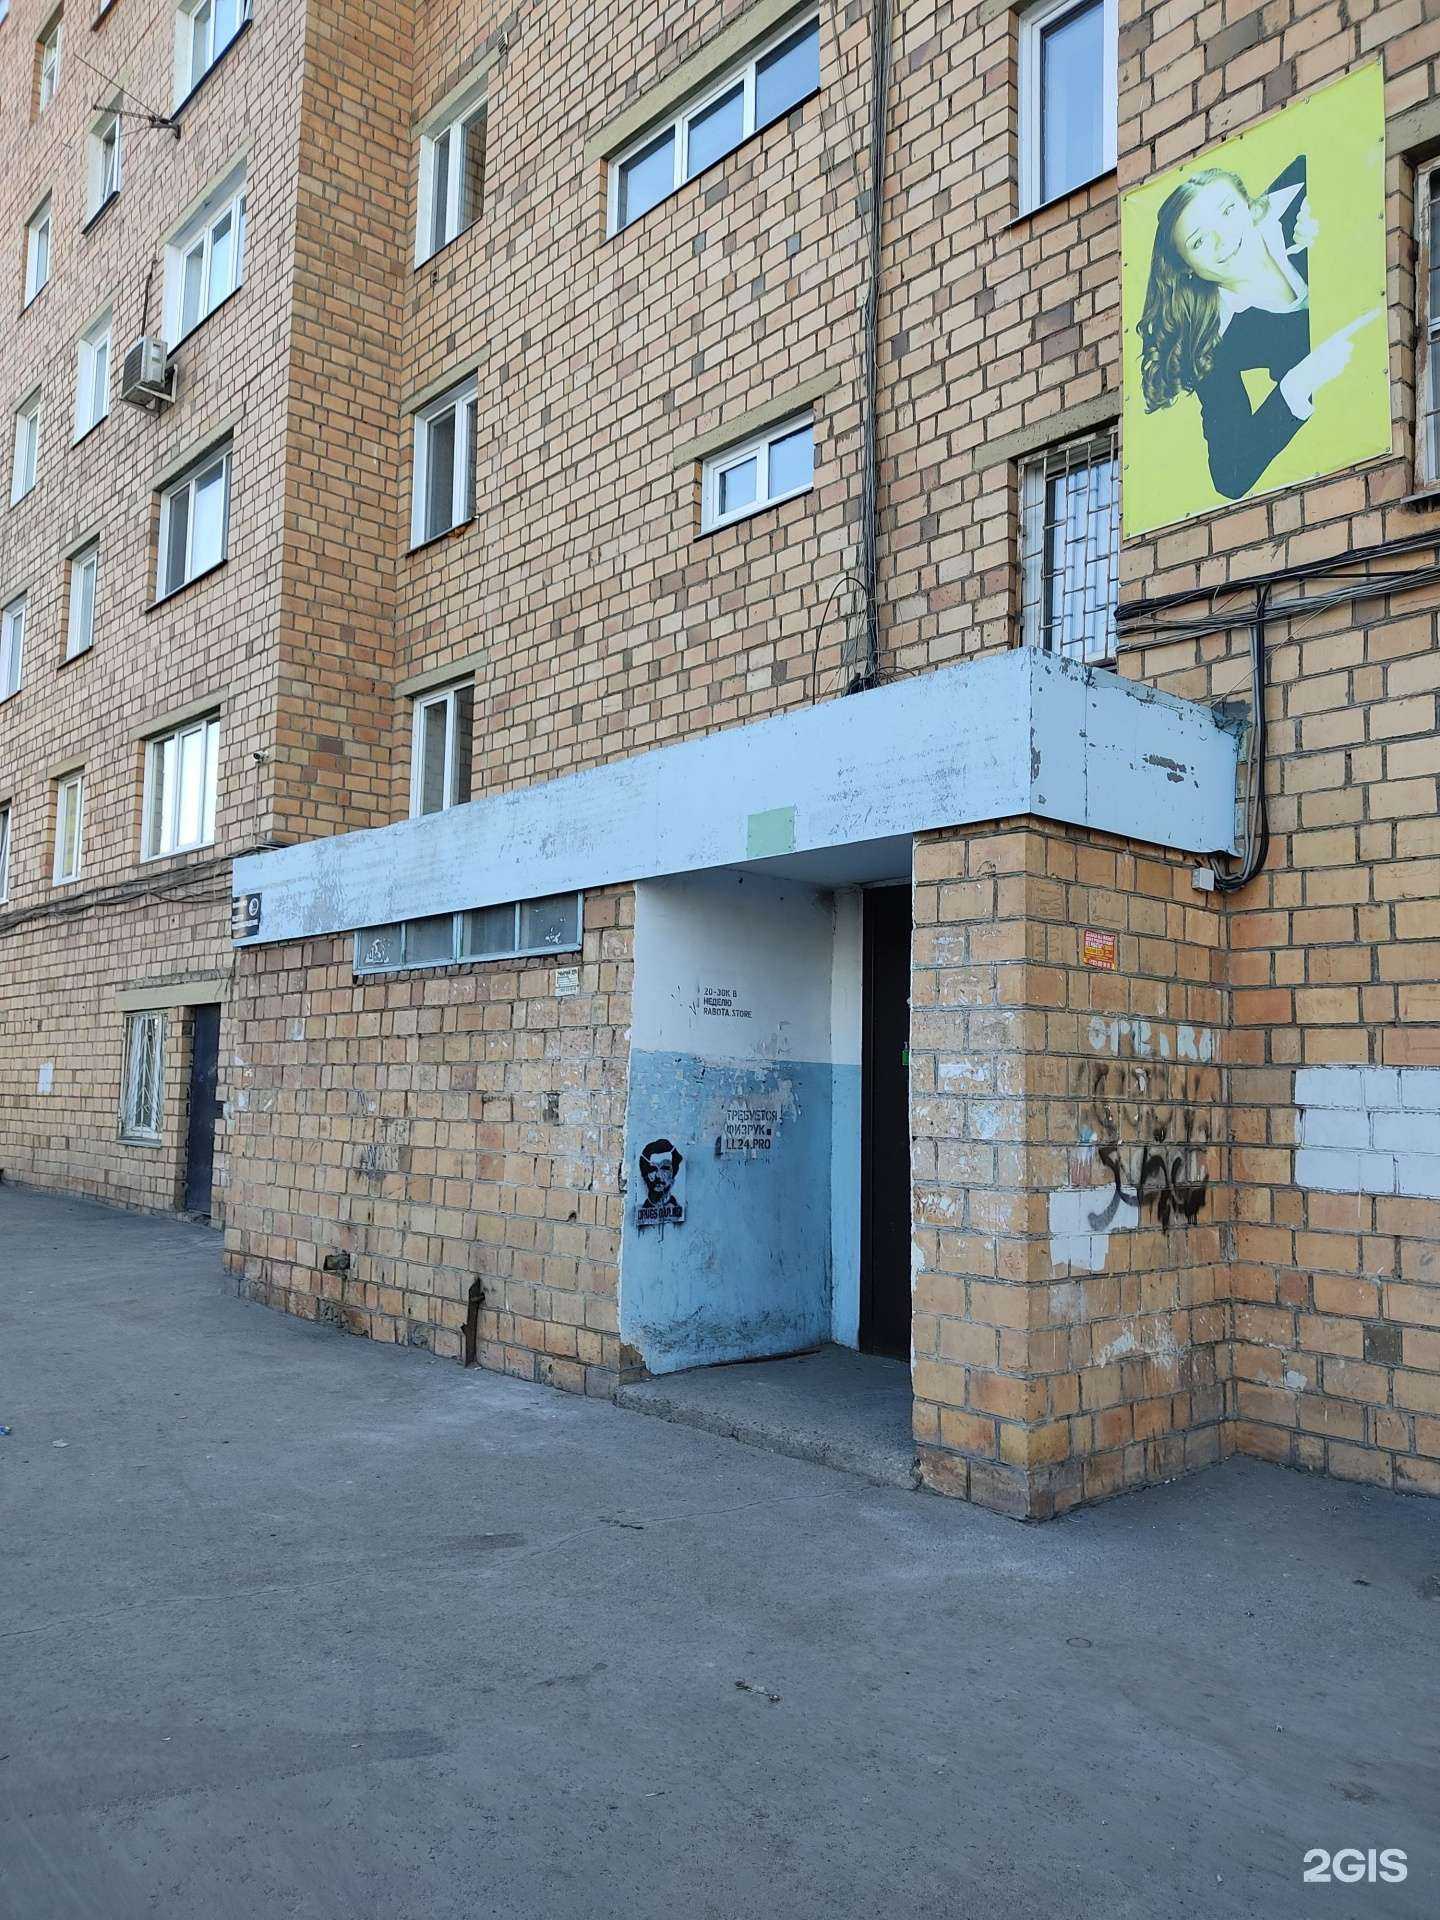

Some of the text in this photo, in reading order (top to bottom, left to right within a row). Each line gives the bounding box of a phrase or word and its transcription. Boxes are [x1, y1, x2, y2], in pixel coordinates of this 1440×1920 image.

[703, 997, 733, 1007] НЕДЕЛЮ
[703, 1007, 753, 1018] RABOTA.STORE
[726, 1109, 778, 1122] ТРЕБУЕТСЯ
[726, 1138, 771, 1149] LL24.PRO
